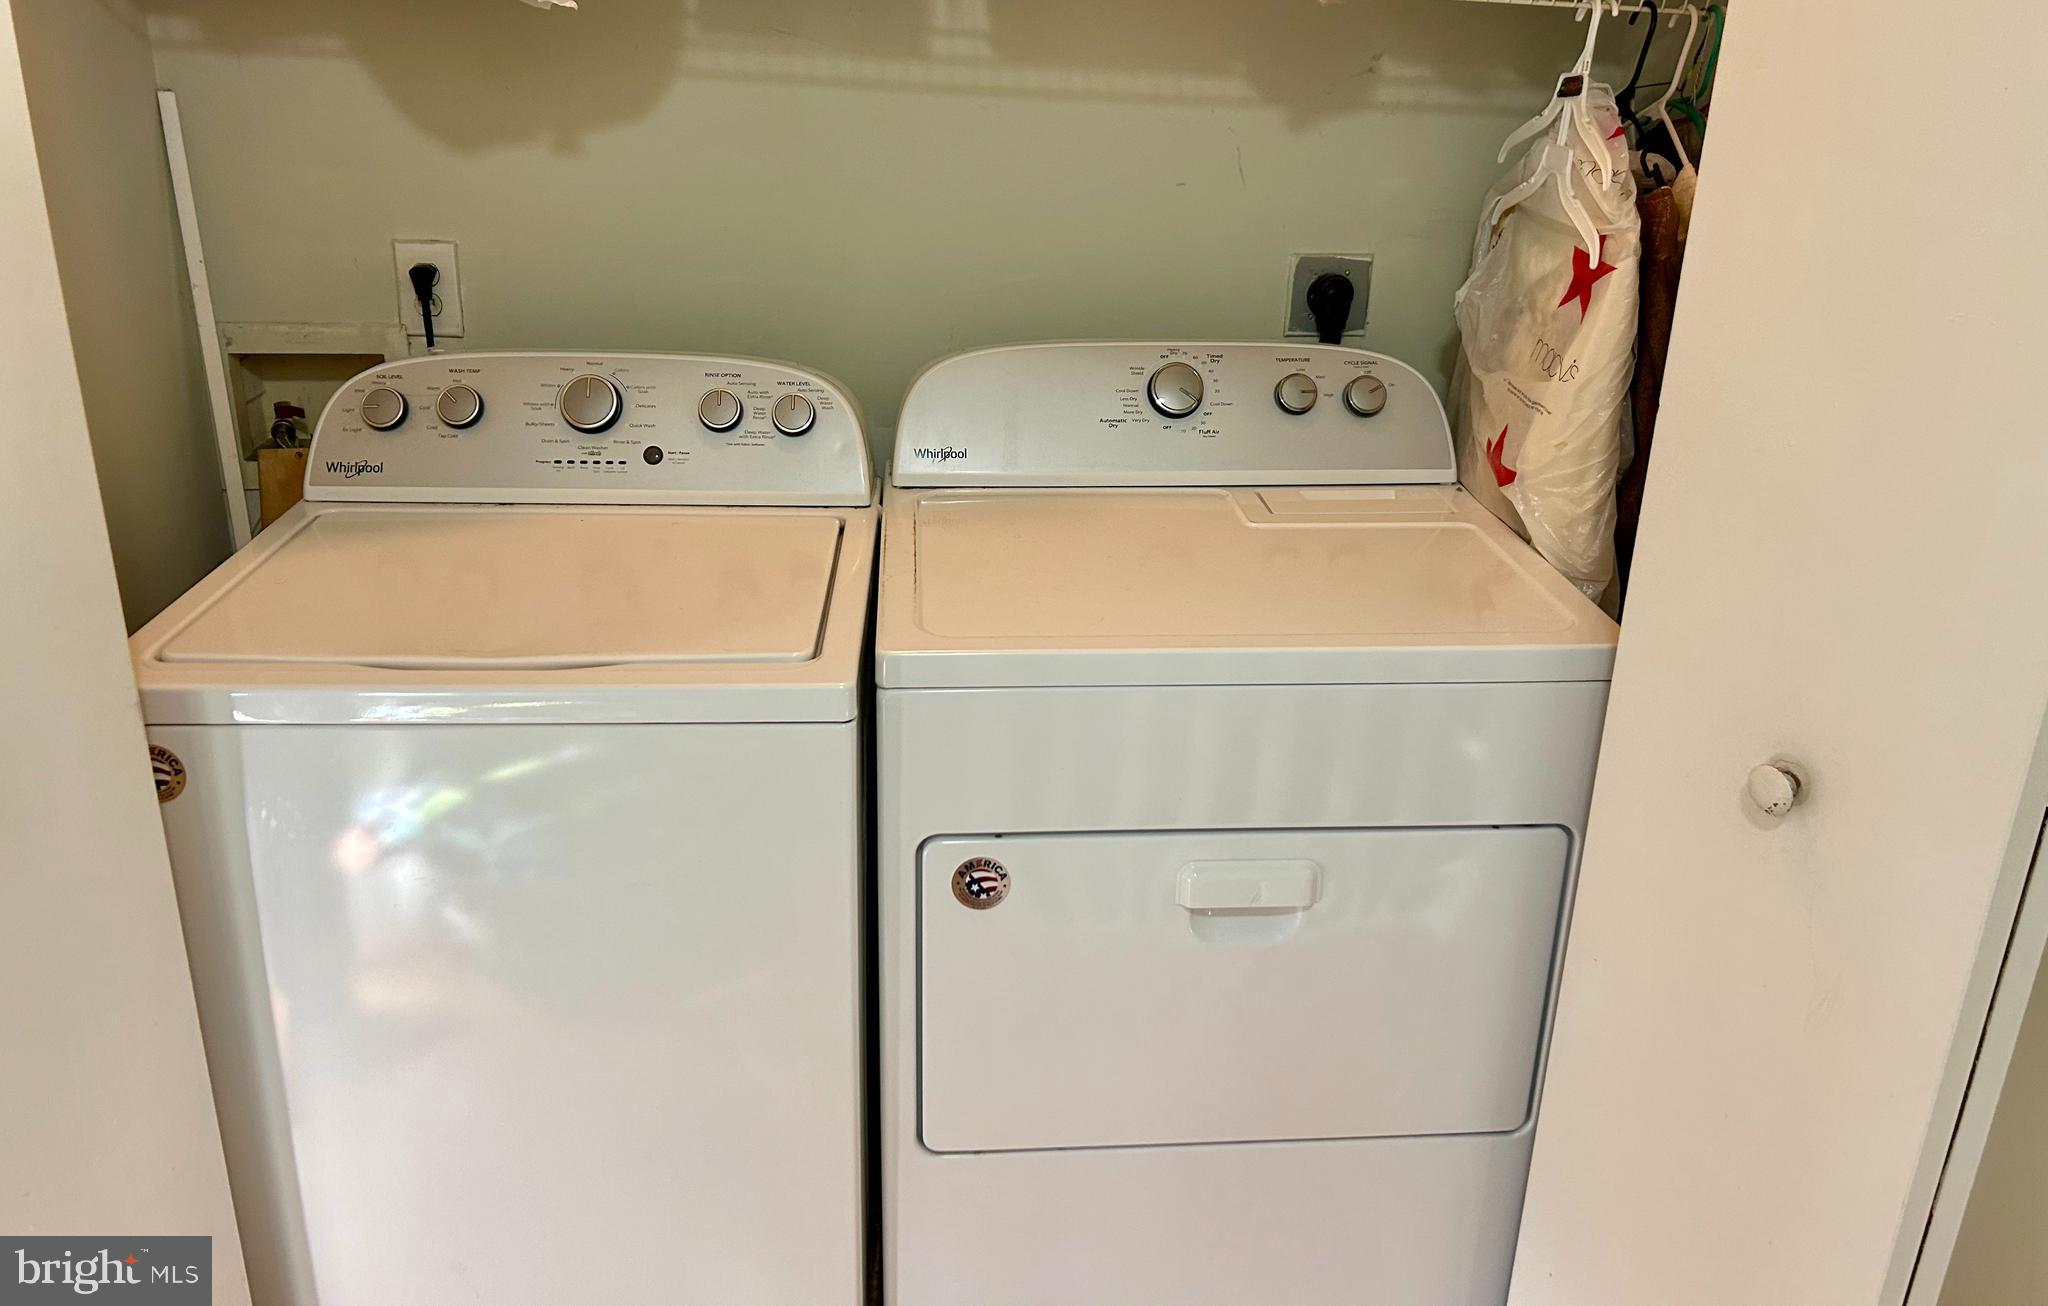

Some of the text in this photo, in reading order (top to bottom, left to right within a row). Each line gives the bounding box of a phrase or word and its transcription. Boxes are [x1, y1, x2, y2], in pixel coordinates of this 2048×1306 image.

[914, 446, 967, 463] Whirlpool
[326, 460, 383, 478] Whirlpool
[957, 859, 1007, 881] AMERICA
